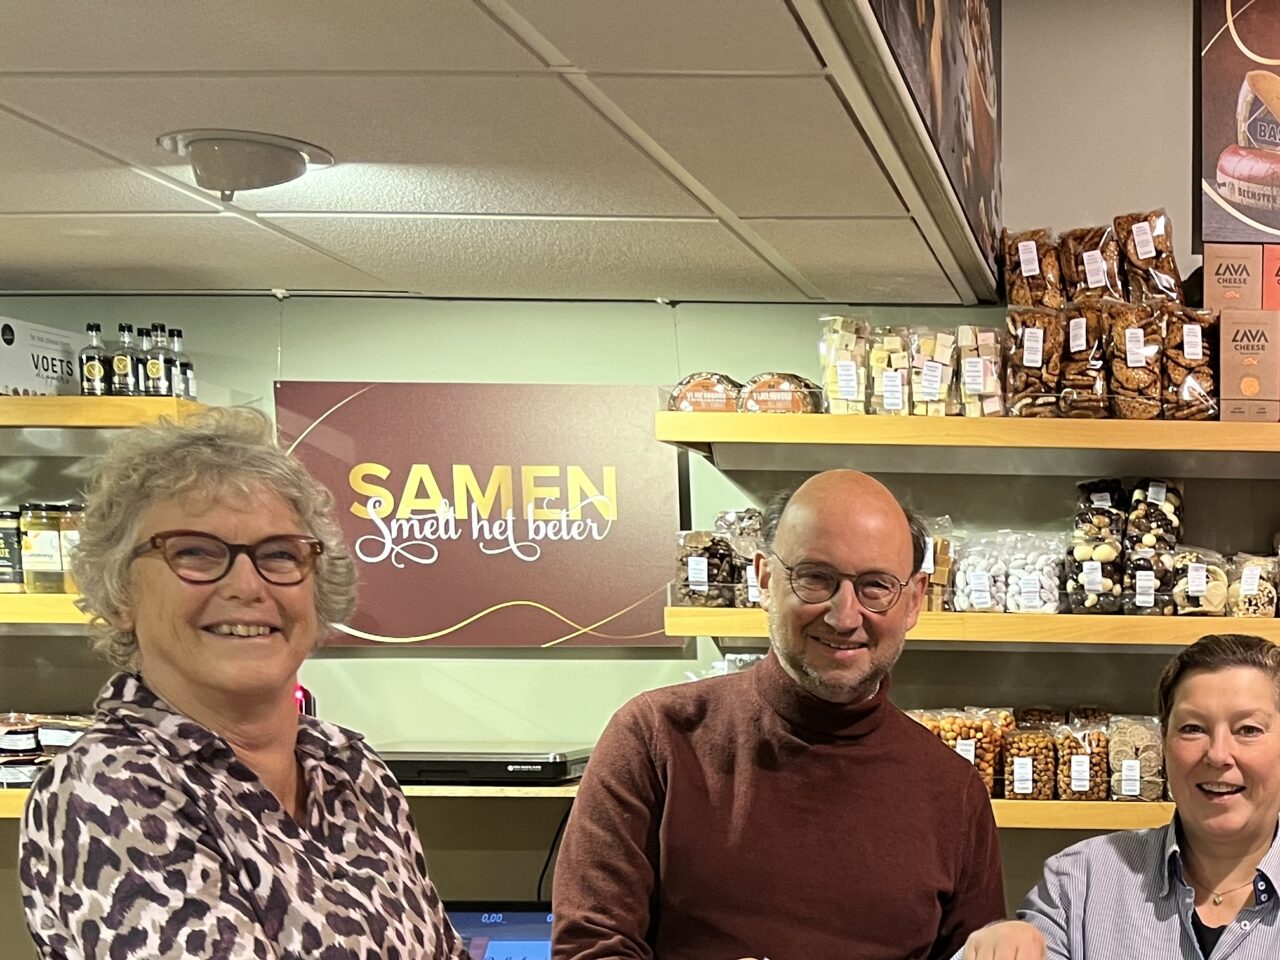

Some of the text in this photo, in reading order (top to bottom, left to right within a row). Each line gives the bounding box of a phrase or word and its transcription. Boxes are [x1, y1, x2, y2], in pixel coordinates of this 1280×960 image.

[1215, 263, 1250, 277] LAVA
[1217, 277, 1248, 285] CHEESE
[1231, 329, 1269, 343] LAVA
[1234, 343, 1266, 351] CHEESE
[31, 353, 74, 377] VOETS
[348, 462, 618, 521] SAMEN
[471, 502, 541, 561] het
[527, 495, 613, 541] beter
[481, 913, 503, 924] 0,00
